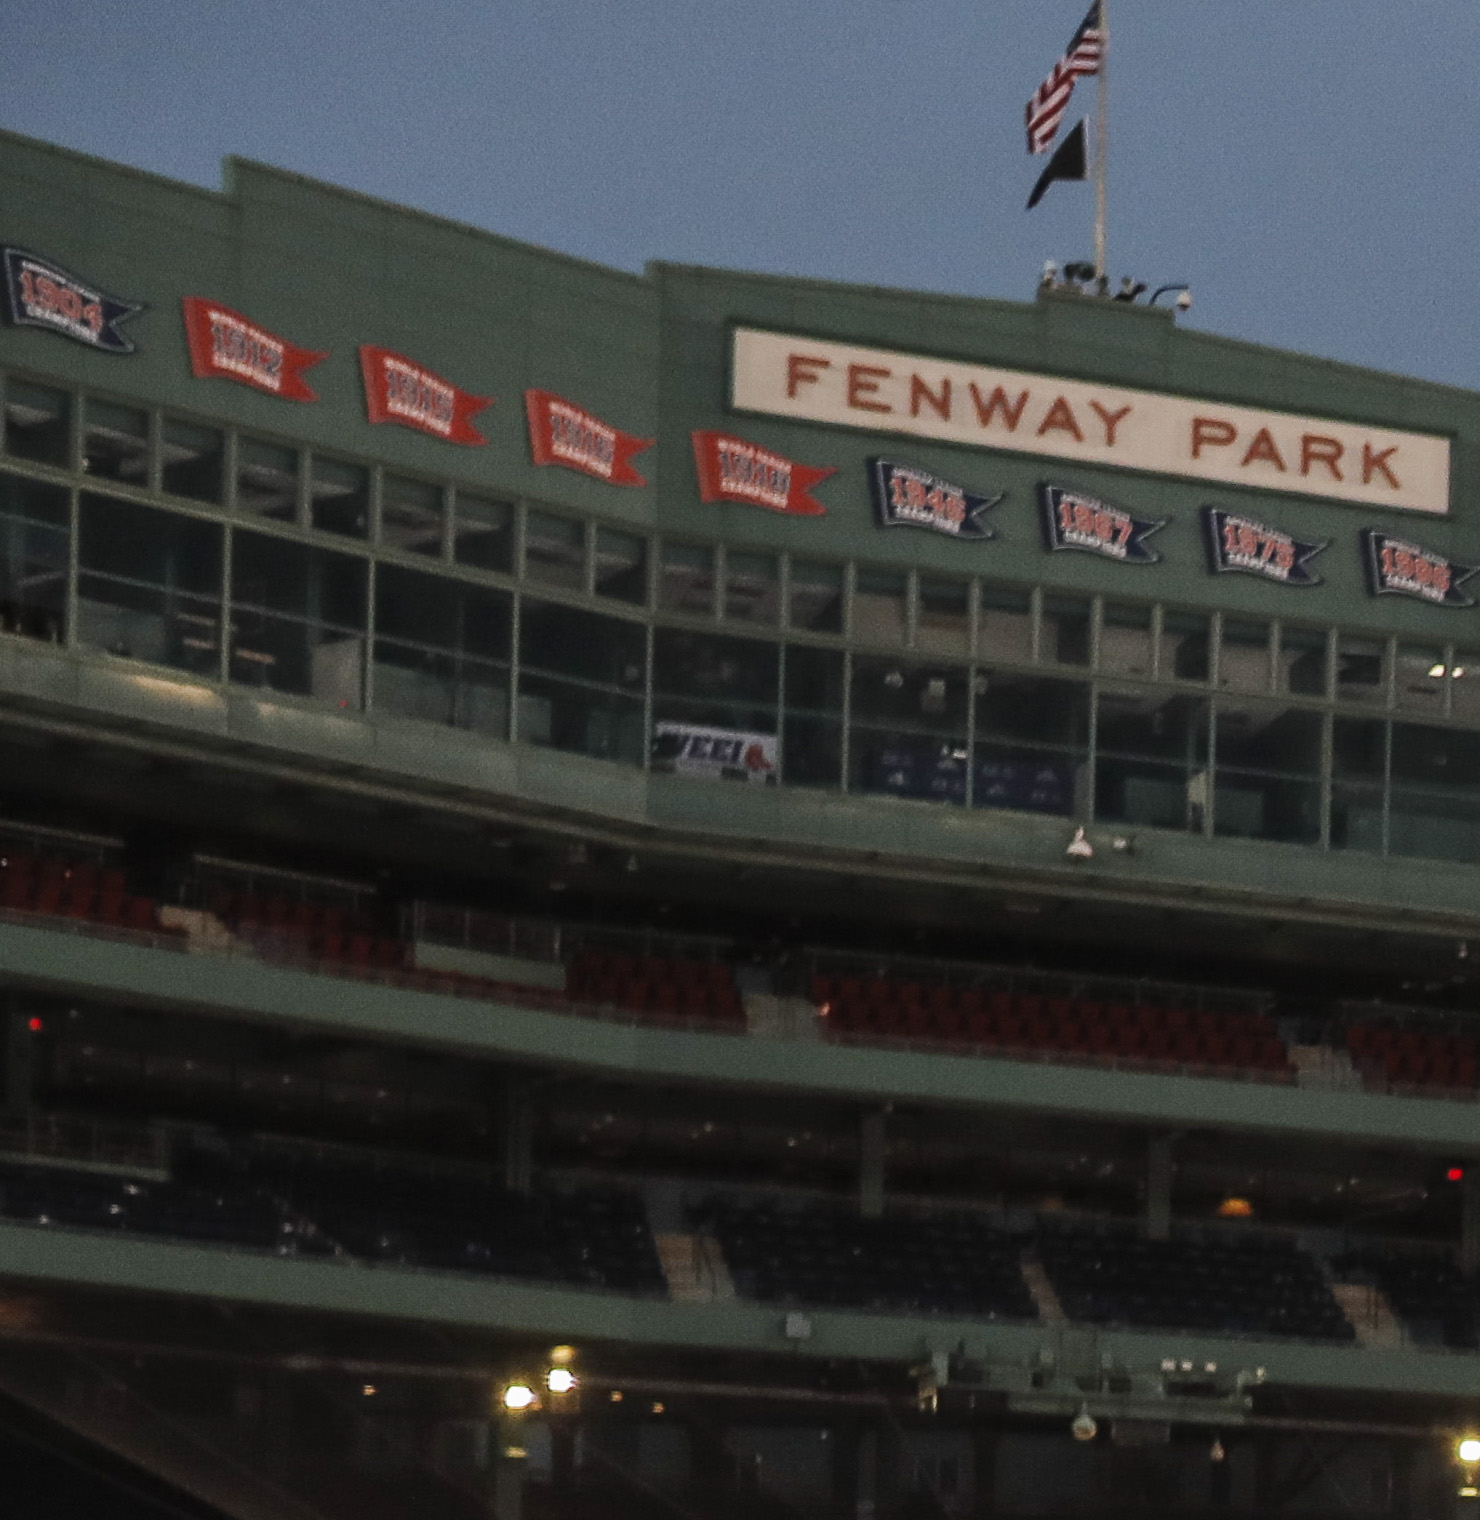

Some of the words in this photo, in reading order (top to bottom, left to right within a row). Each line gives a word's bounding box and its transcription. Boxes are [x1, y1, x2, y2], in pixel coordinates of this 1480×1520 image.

[785, 354, 1132, 447] FENWAY
[1191, 418, 1402, 490] PARK
[1059, 501, 1133, 546] 1967
